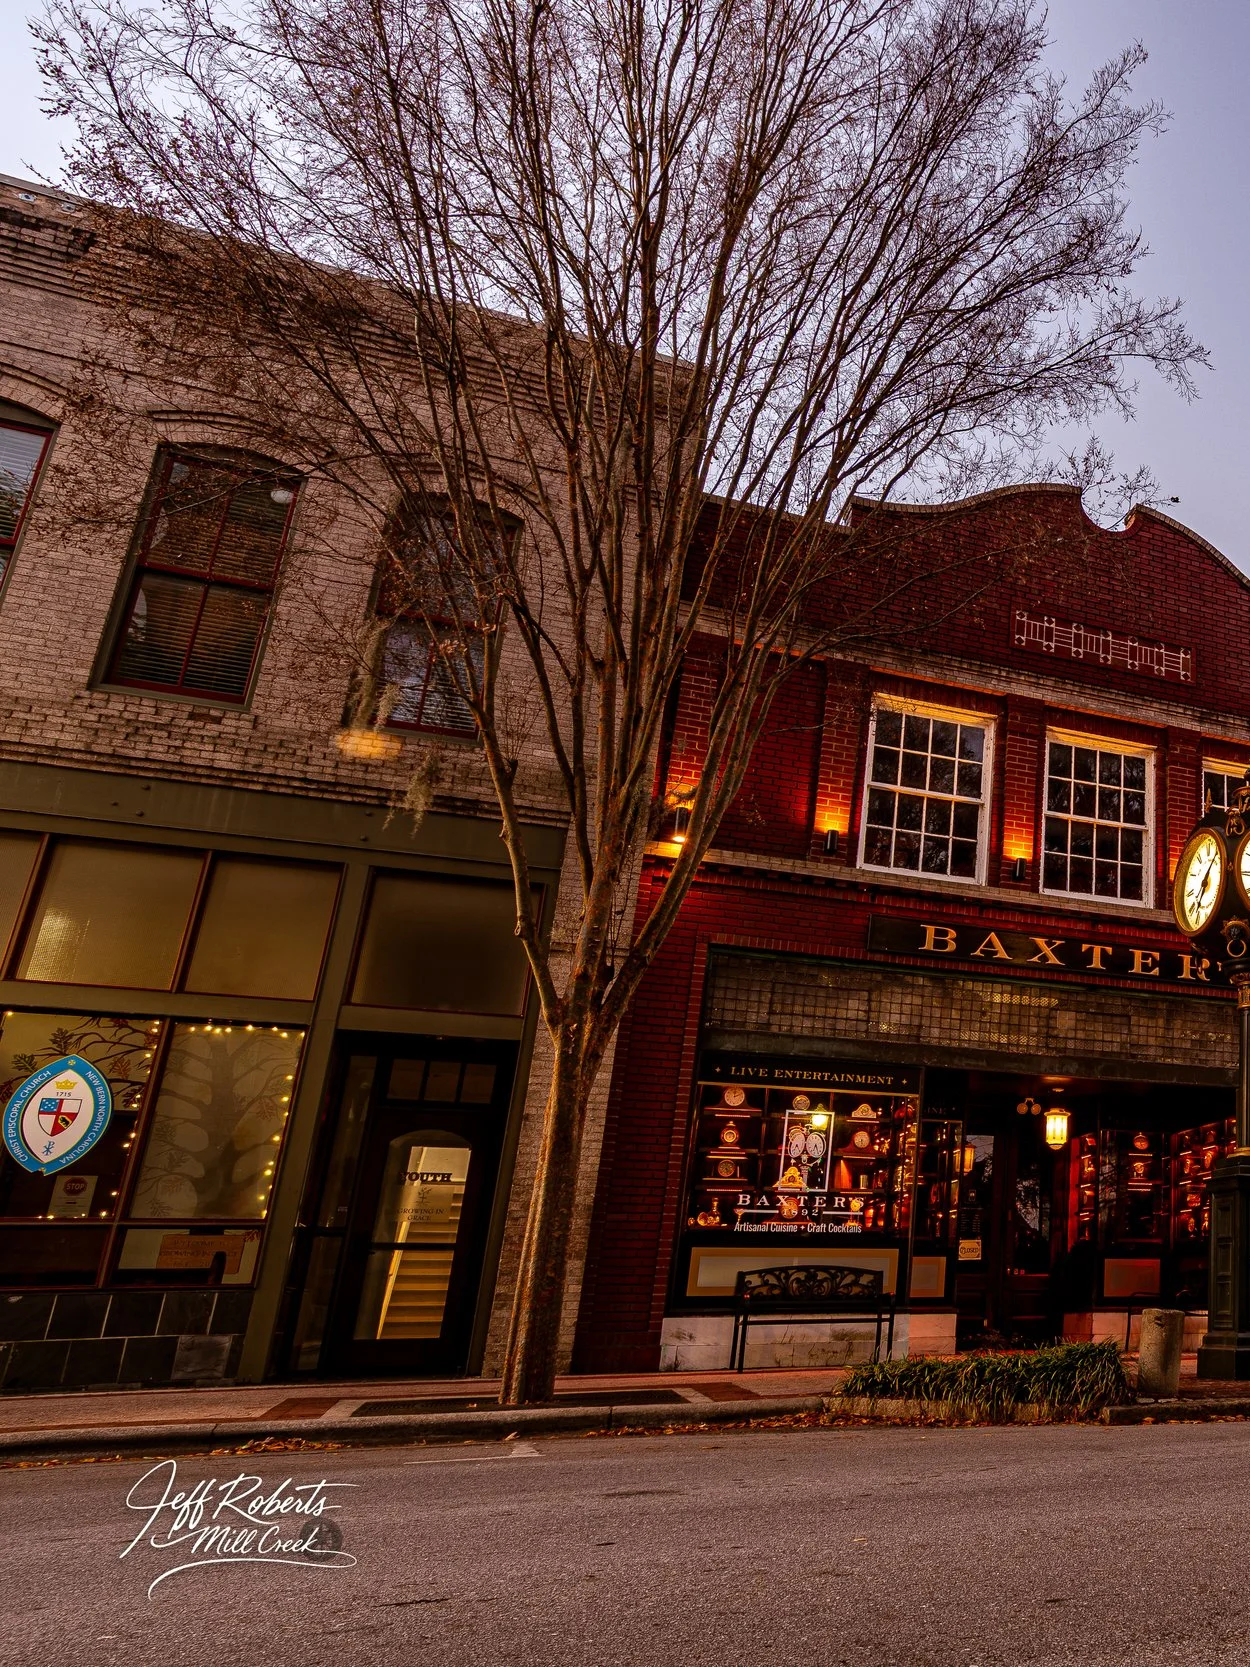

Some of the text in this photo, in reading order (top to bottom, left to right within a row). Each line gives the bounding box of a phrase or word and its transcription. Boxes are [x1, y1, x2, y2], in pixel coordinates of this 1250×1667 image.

[918, 924, 1222, 981] BAXTER'
[731, 1067, 894, 1084] LIVE ENTERTAINMENT
[7, 1070, 52, 1162] CHRIST EPISCOPAL CHURCH
[59, 1070, 106, 1164] NEW BERN NORTH CAROLINA
[737, 1194, 865, 1208] BAXTER'S
[783, 1208, 819, 1216] 1892
[734, 1222, 862, 1233] Artisanal Cuisine Craft Cocktails
